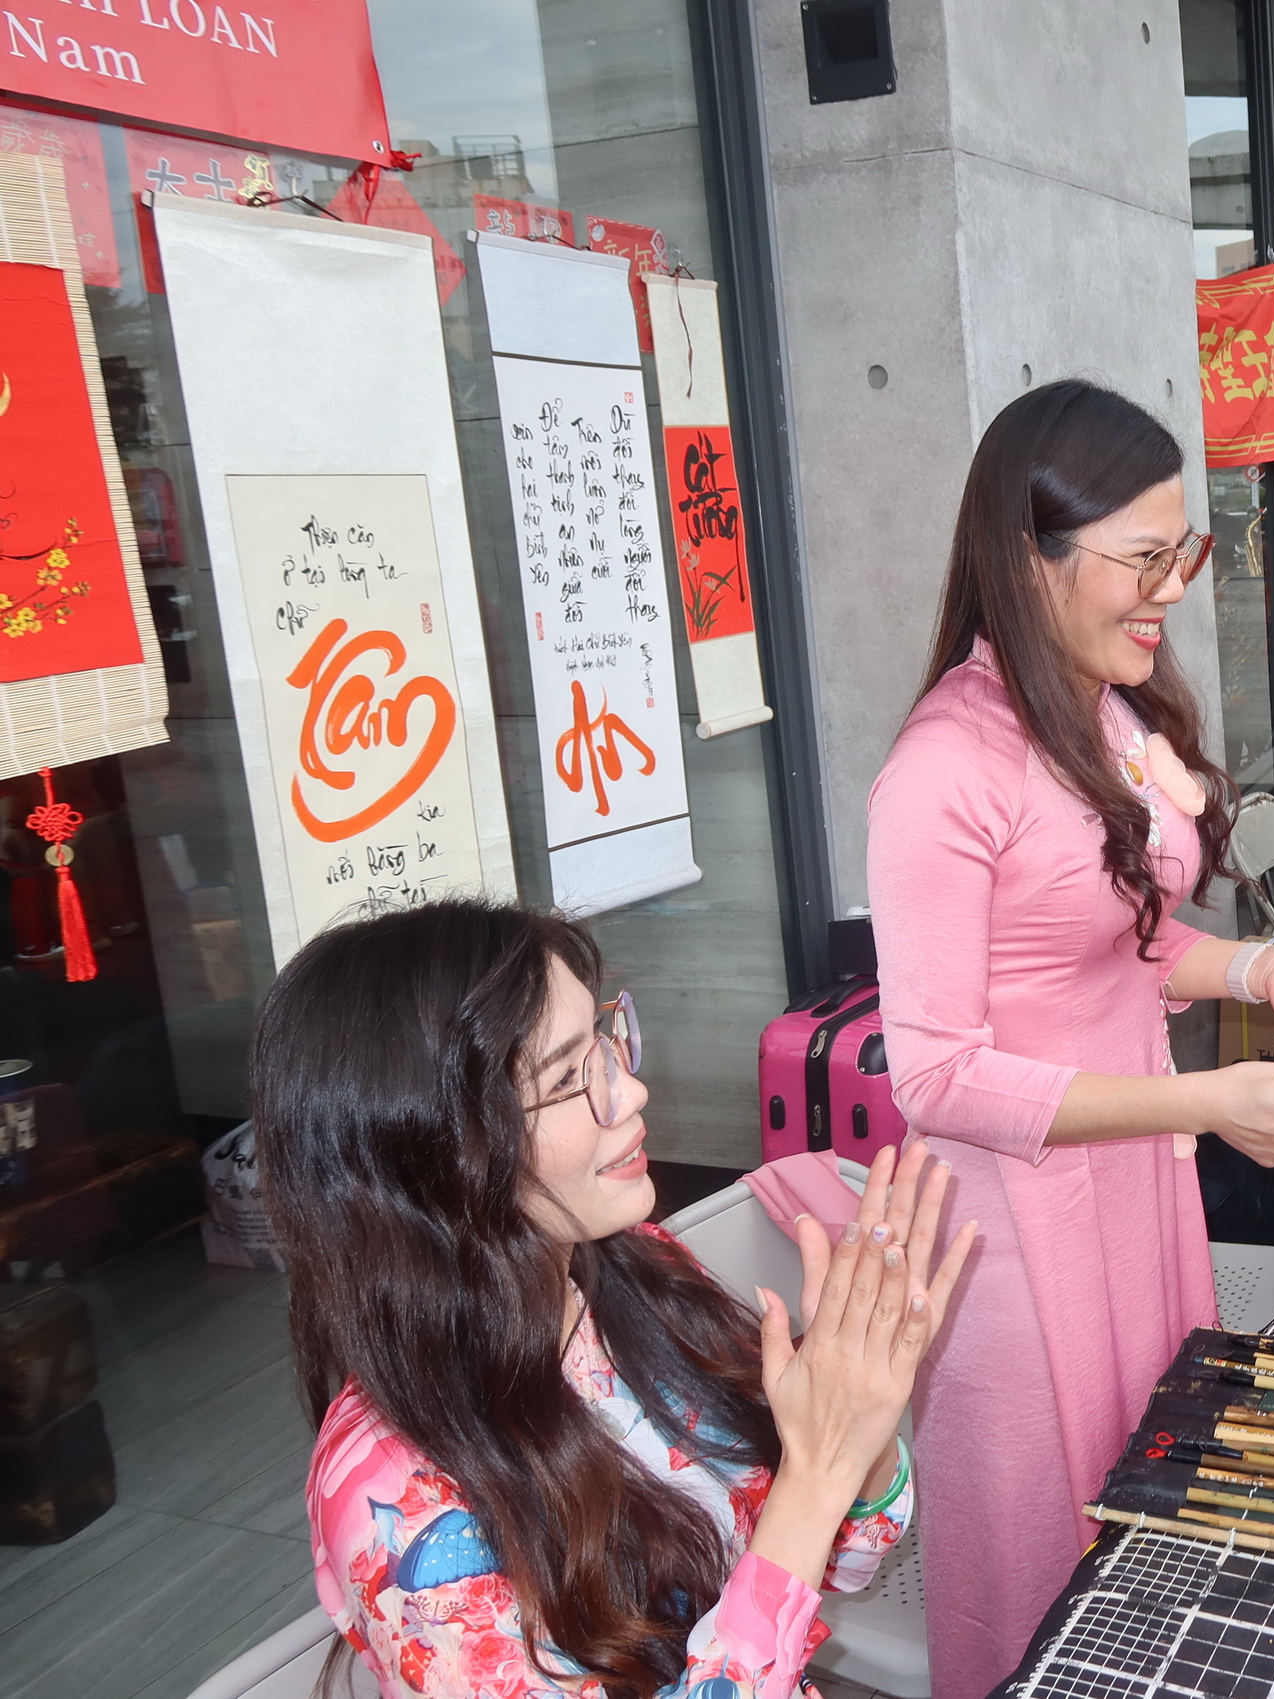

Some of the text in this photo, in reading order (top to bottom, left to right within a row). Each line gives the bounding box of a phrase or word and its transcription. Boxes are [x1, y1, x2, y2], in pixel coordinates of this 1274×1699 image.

[2, 10, 147, 85] Nam
[139, 0, 279, 58] LOAN
[558, 523, 576, 542] an
[415, 830, 445, 863] ba
